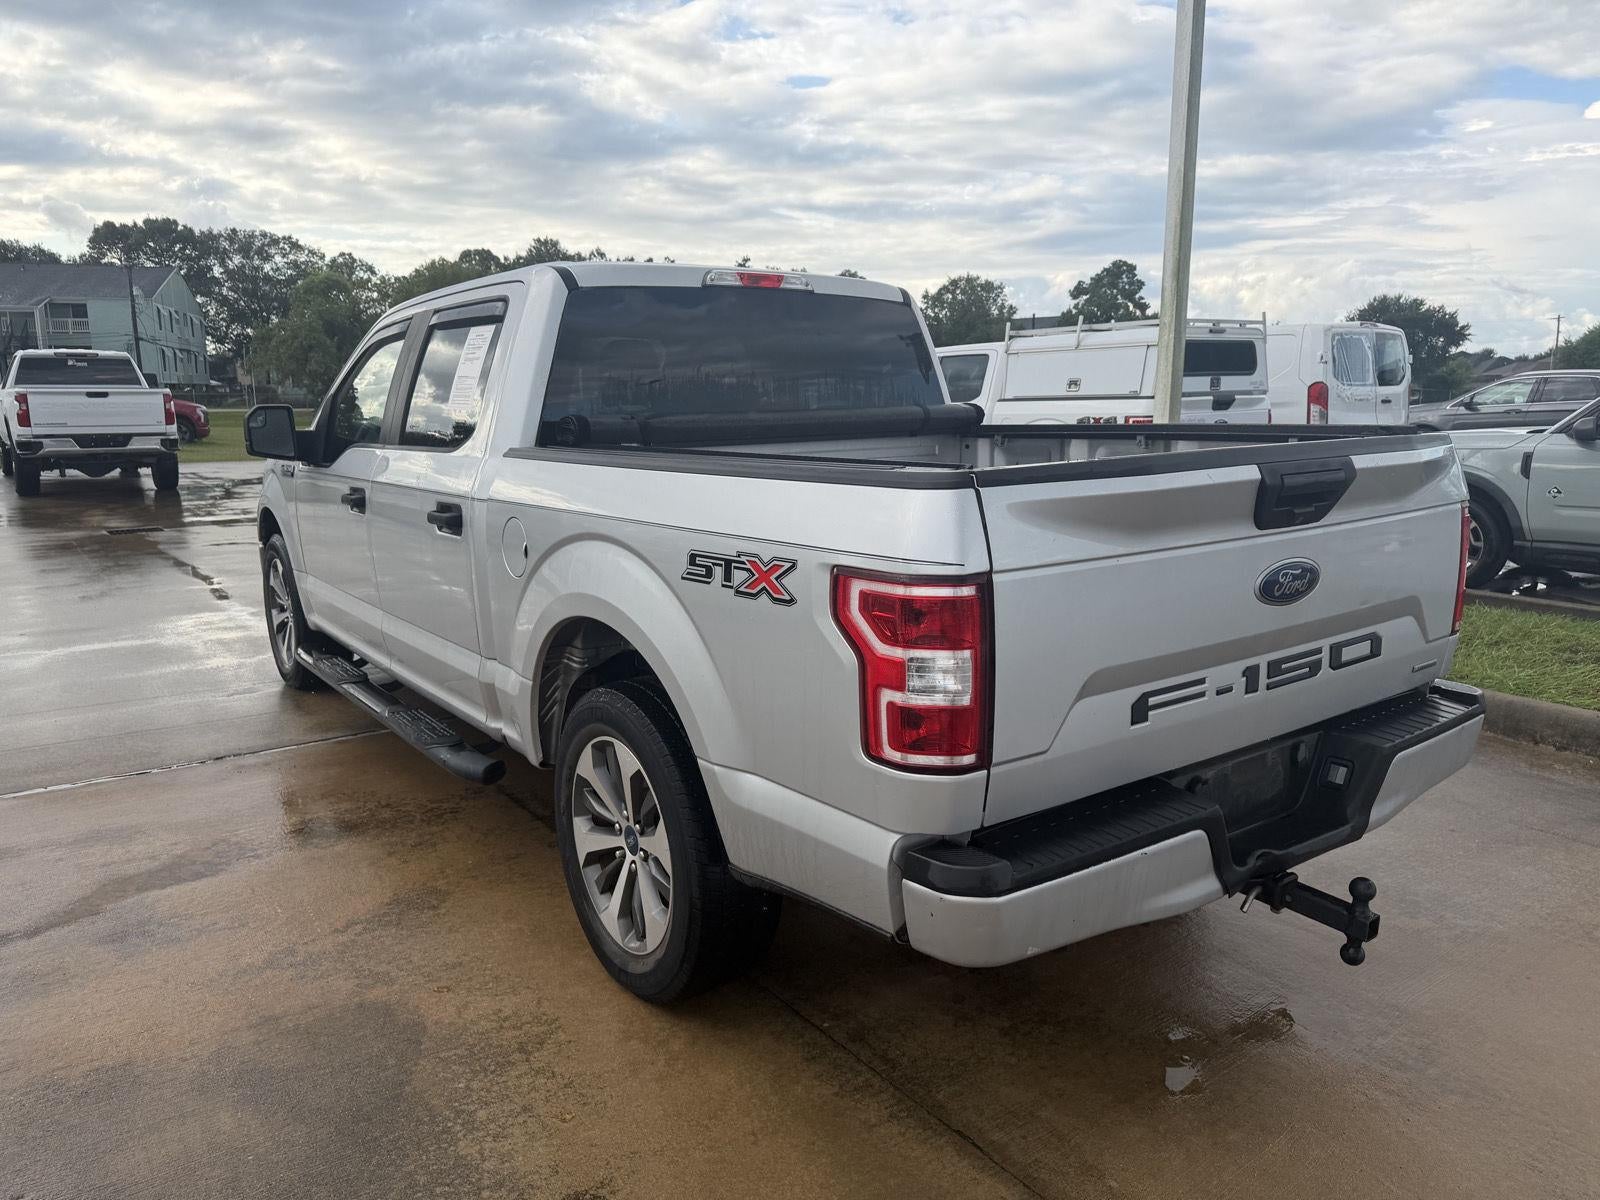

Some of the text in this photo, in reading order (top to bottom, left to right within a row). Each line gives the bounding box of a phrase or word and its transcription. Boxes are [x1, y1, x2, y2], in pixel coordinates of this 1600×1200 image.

[681, 549, 797, 606] STX
[1274, 568, 1310, 596] Ford
[1131, 632, 1382, 727] F-150
